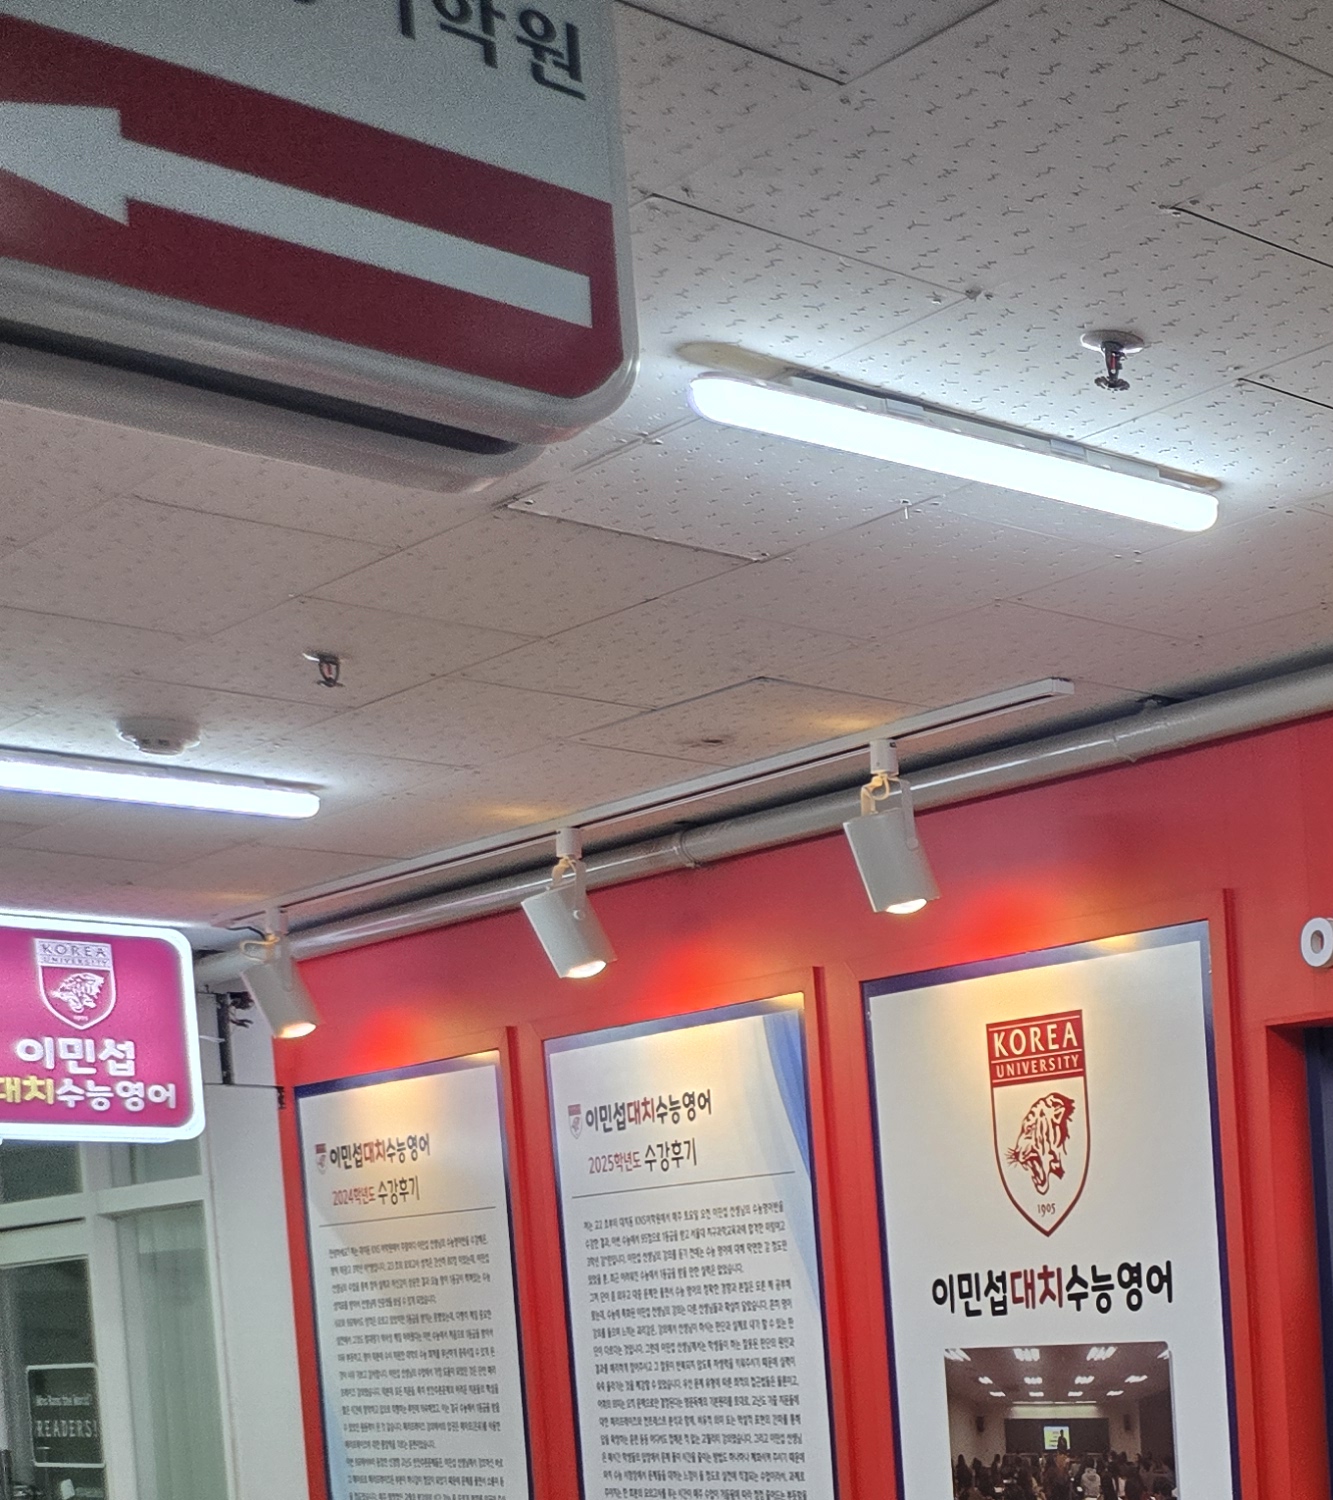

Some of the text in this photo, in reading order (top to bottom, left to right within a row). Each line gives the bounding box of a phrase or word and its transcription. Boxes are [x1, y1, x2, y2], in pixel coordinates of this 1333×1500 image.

[40, 943, 107, 958] KOREA
[16, 1036, 136, 1077] 이민섭
[993, 1021, 1079, 1058] KOREA
[996, 1054, 1079, 1079] UNIVERSITY
[585, 1088, 712, 1134] 이민섭대치수능영어
[329, 1133, 430, 1170] 이민섭대치수능영어
[588, 1138, 697, 1174] 2025학년도 수강후기
[377, 1175, 421, 1205] 수강후기
[1038, 1203, 1056, 1217] 1905
[932, 1260, 1173, 1317] 이민섭대치수능영어
